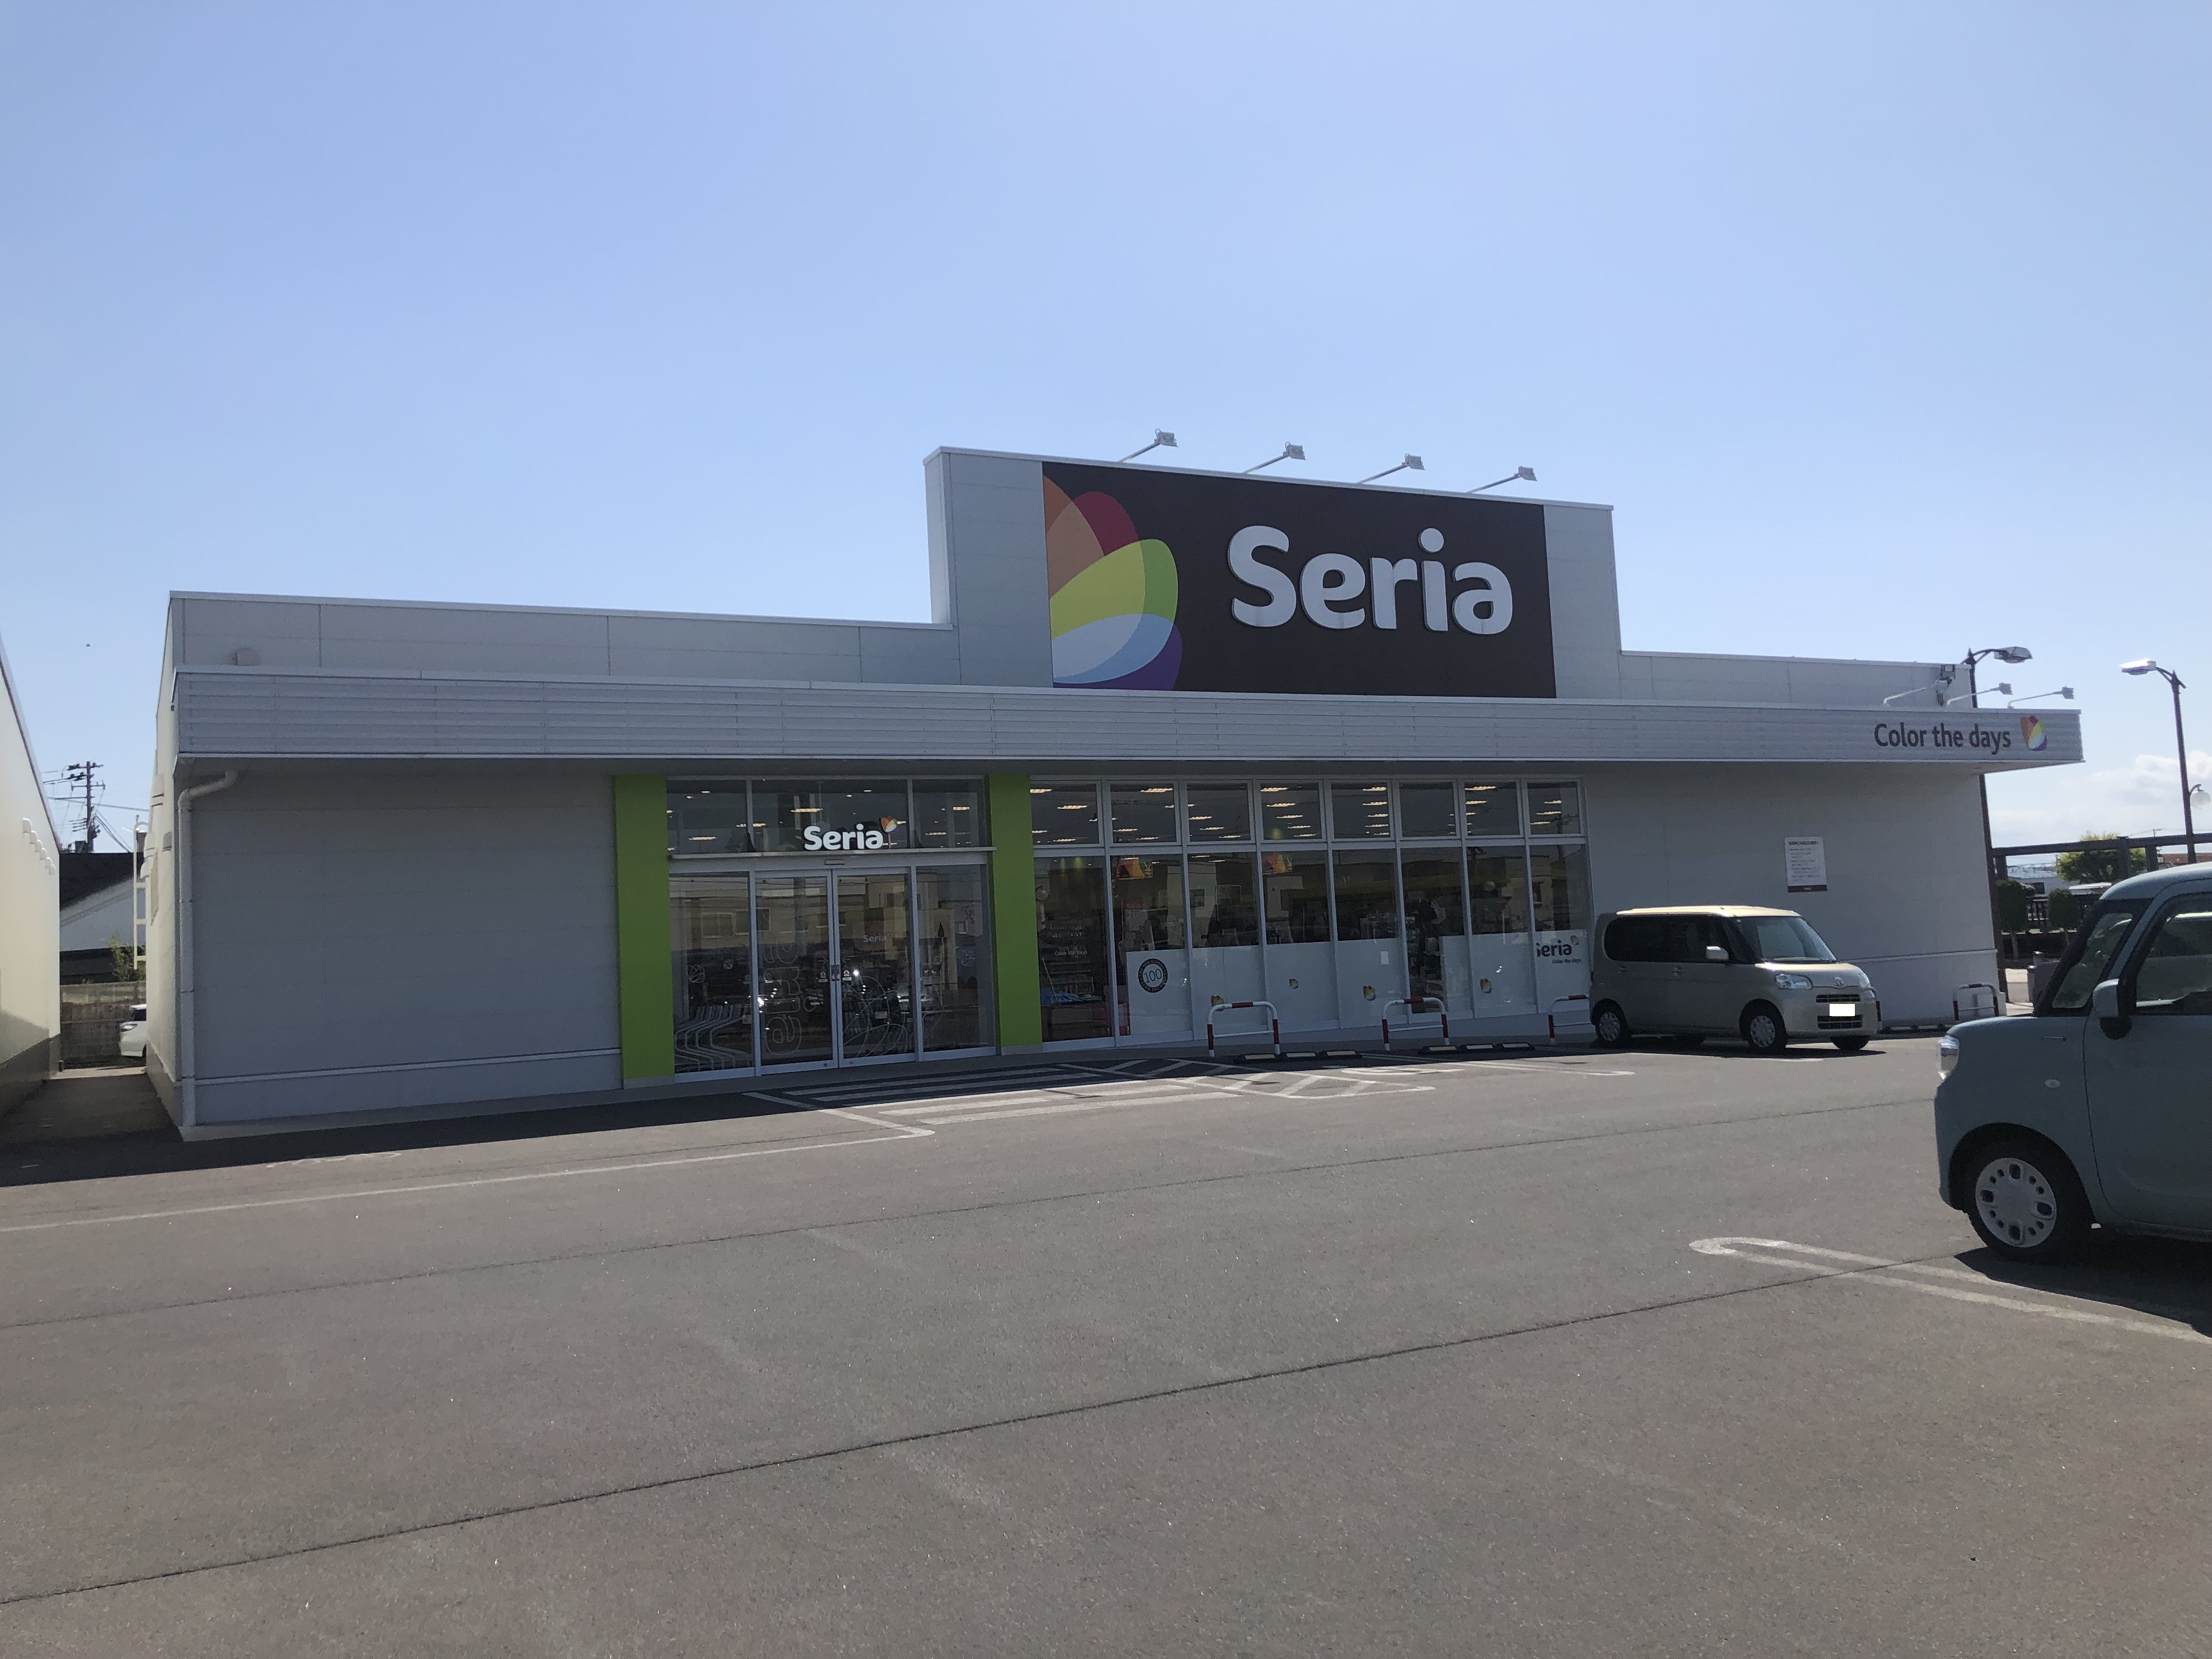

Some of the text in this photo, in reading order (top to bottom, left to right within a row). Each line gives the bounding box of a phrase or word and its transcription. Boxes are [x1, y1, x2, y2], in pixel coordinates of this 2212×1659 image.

[1227, 524, 1514, 635] Seria
[1874, 722, 2011, 755] Color the days
[803, 823, 884, 851] Seria
[863, 934, 887, 943] Seria
[1144, 968, 1162, 983] 100
